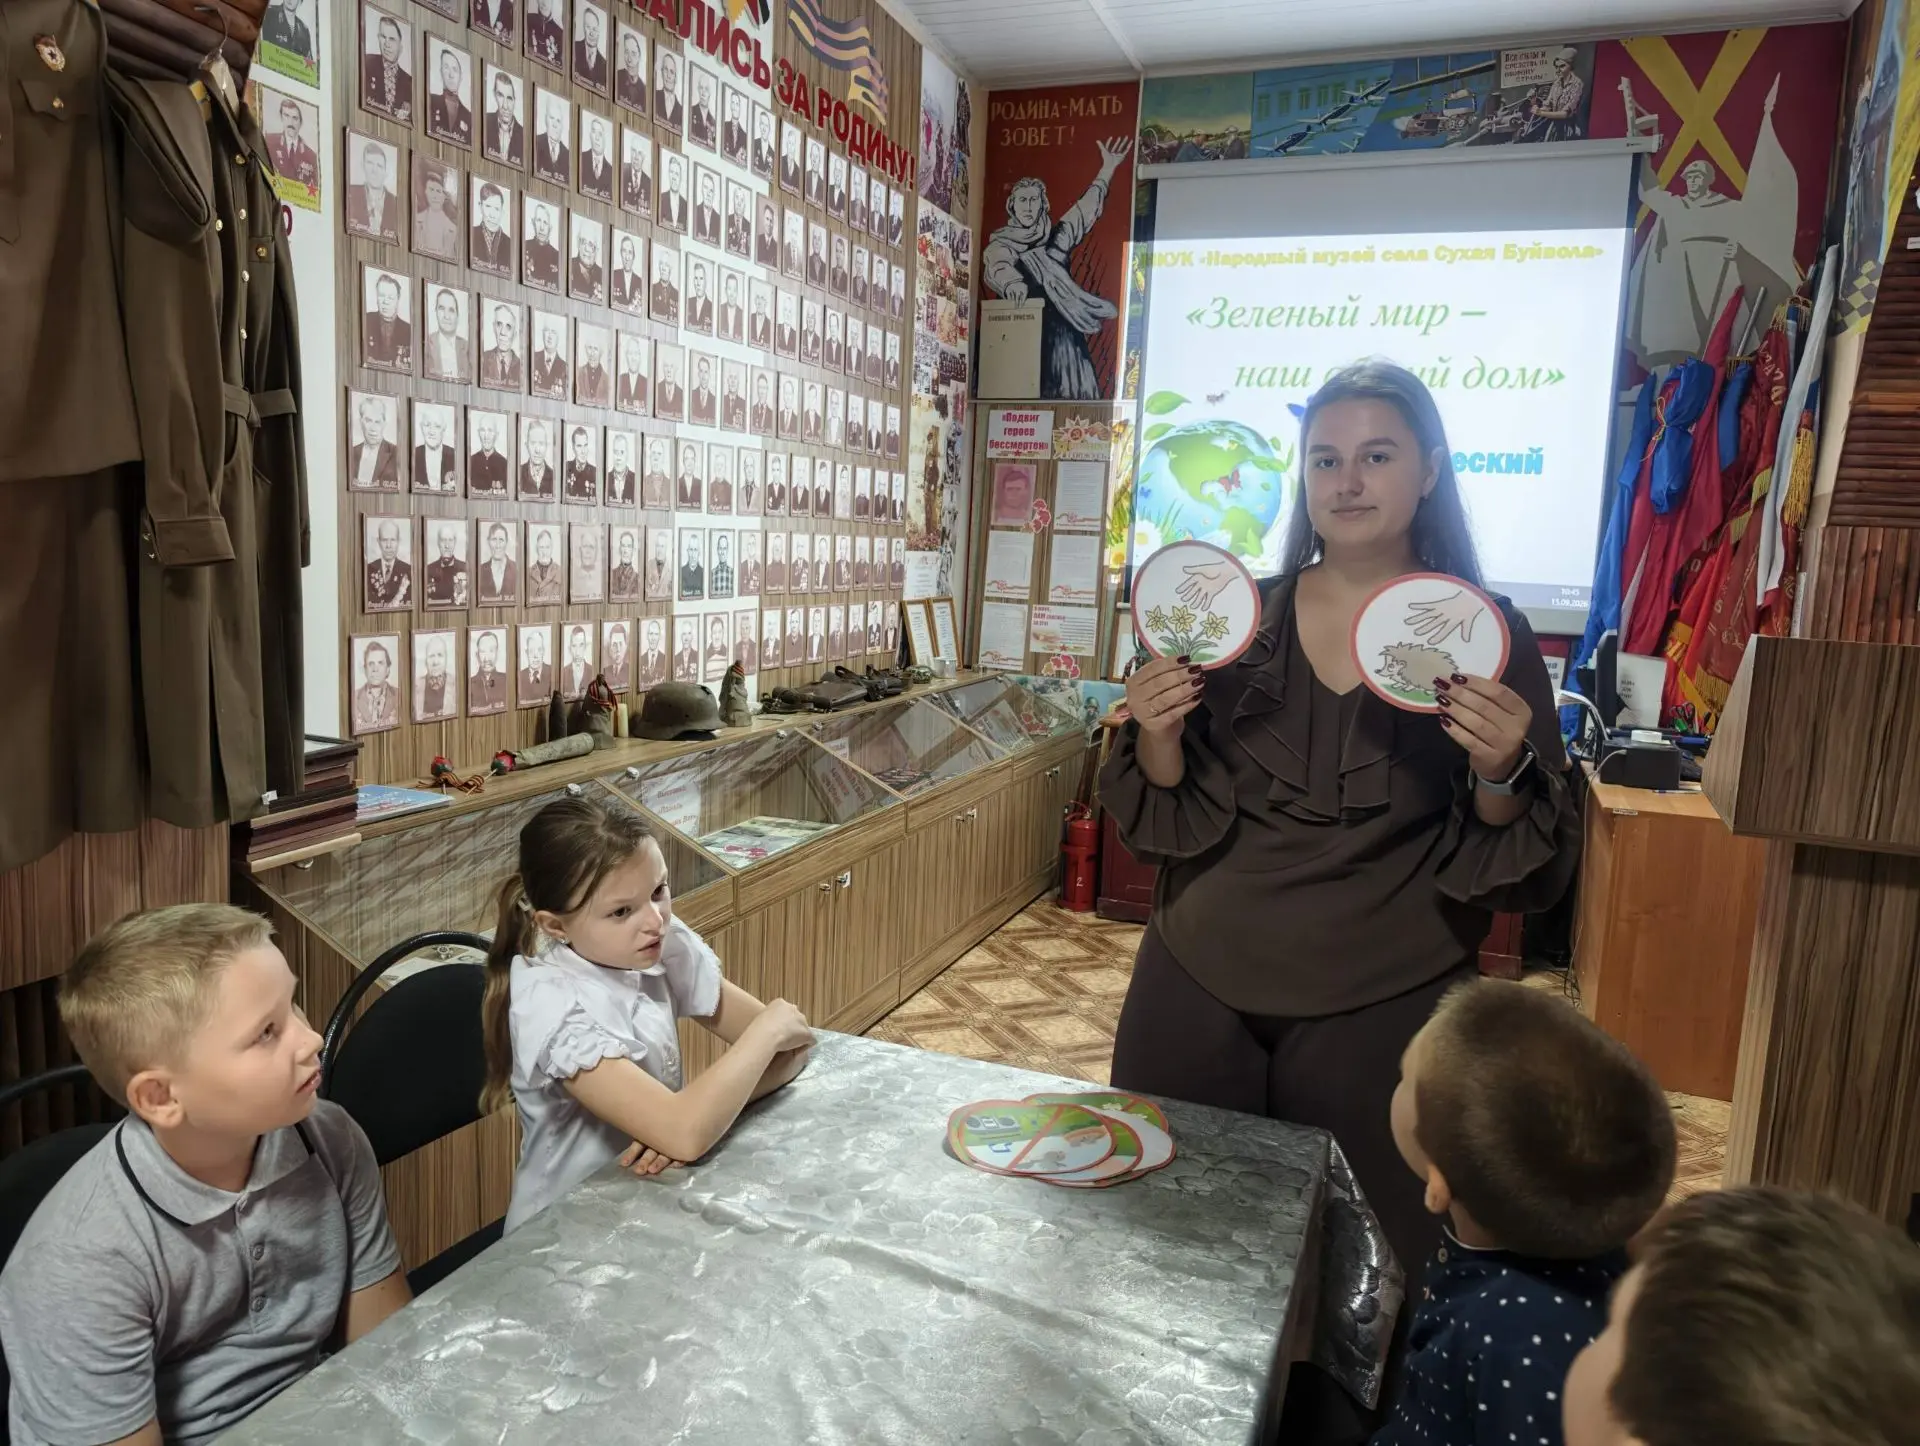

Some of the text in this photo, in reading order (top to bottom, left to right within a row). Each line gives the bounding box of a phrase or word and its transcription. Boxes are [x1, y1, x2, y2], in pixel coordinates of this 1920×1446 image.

[991, 95, 1123, 121] РОДИНА-МАТЬ
[777, 57, 812, 121] ЗА
[817, 87, 916, 191] РОДИНУ!
[1000, 125, 1075, 147] ЗОВЕТ!
[1312, 246, 1375, 267] музей
[1381, 248, 1428, 262] села
[1434, 245, 1496, 264] Сухая
[1185, 294, 1361, 329] «Зеленый
[1370, 304, 1450, 336] мир
[1234, 365, 1312, 388] наш
[1462, 356, 1566, 390] дом»
[1003, 427, 1035, 437] героев
